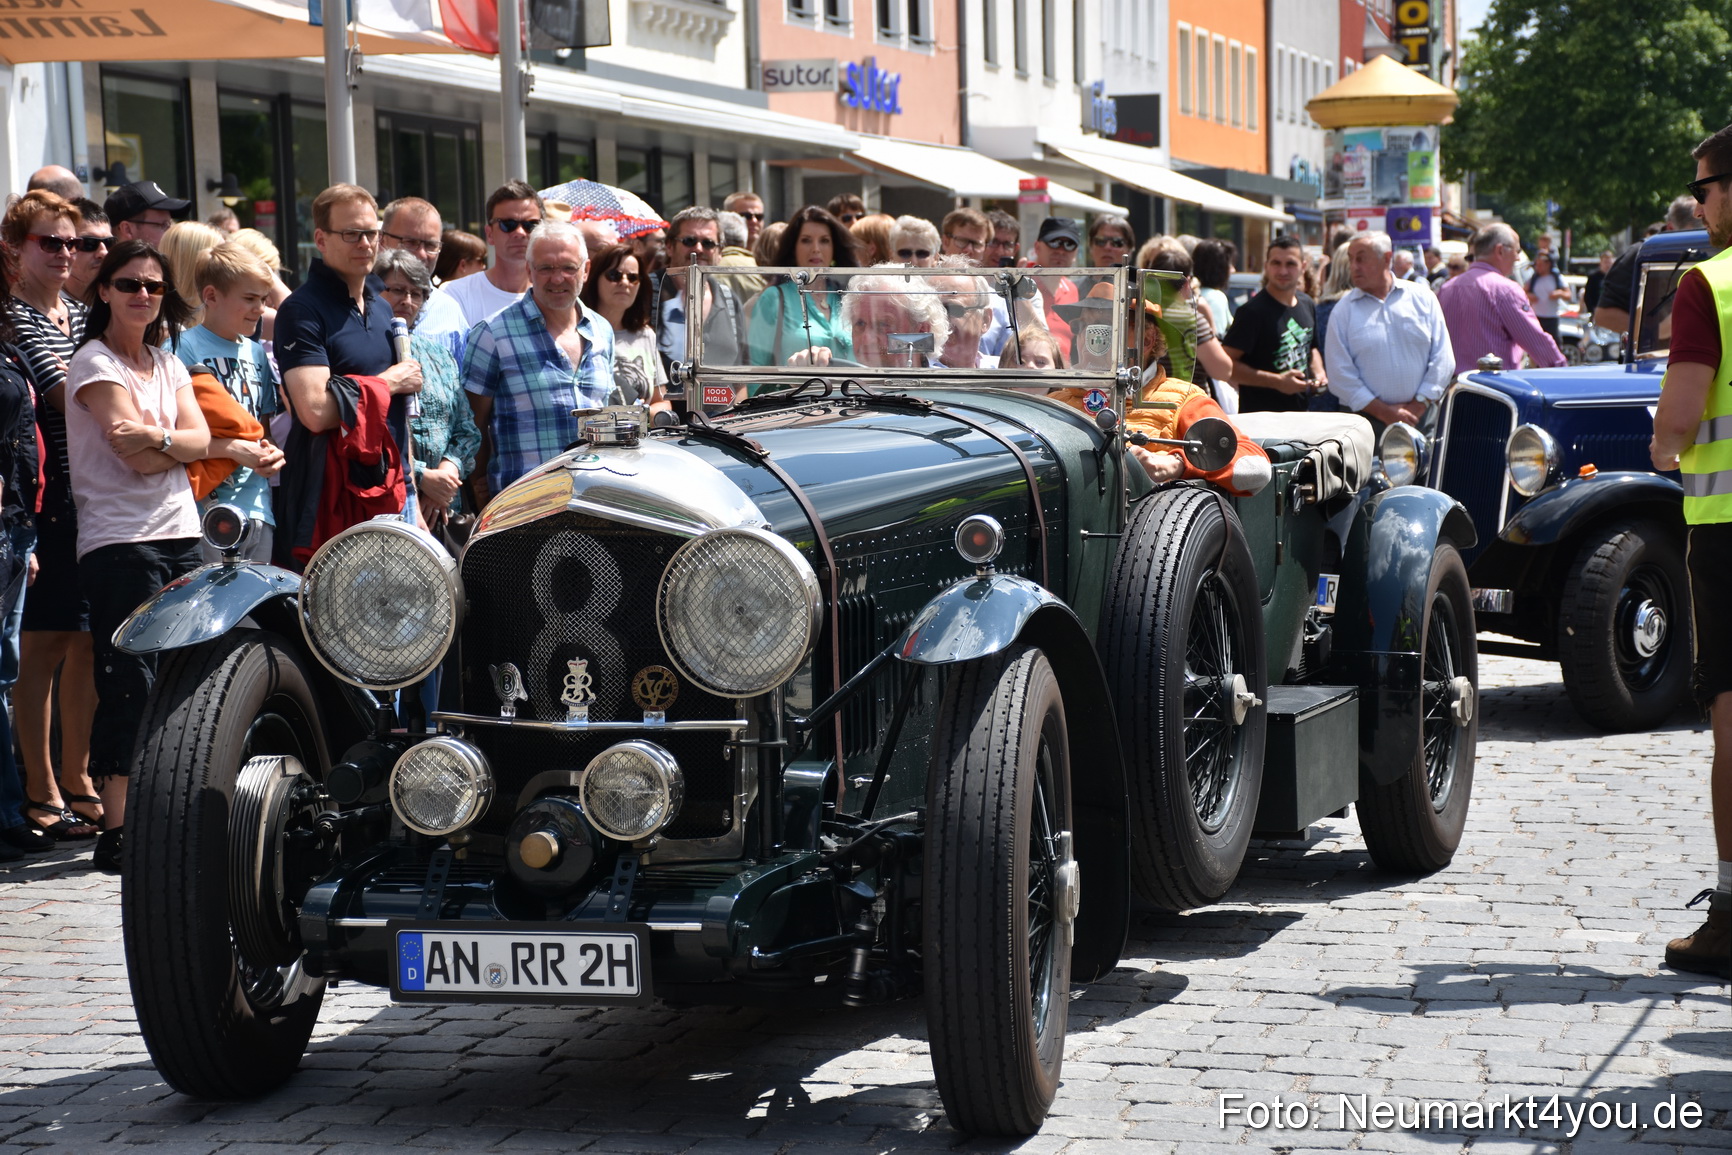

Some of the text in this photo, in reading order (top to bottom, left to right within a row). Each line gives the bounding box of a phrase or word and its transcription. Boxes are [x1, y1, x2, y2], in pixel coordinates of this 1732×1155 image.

[1326, 581, 1336, 604] R
[407, 967, 417, 980] D
[425, 940, 480, 985] AN
[510, 942, 568, 986] RR
[579, 943, 635, 987] 2H
